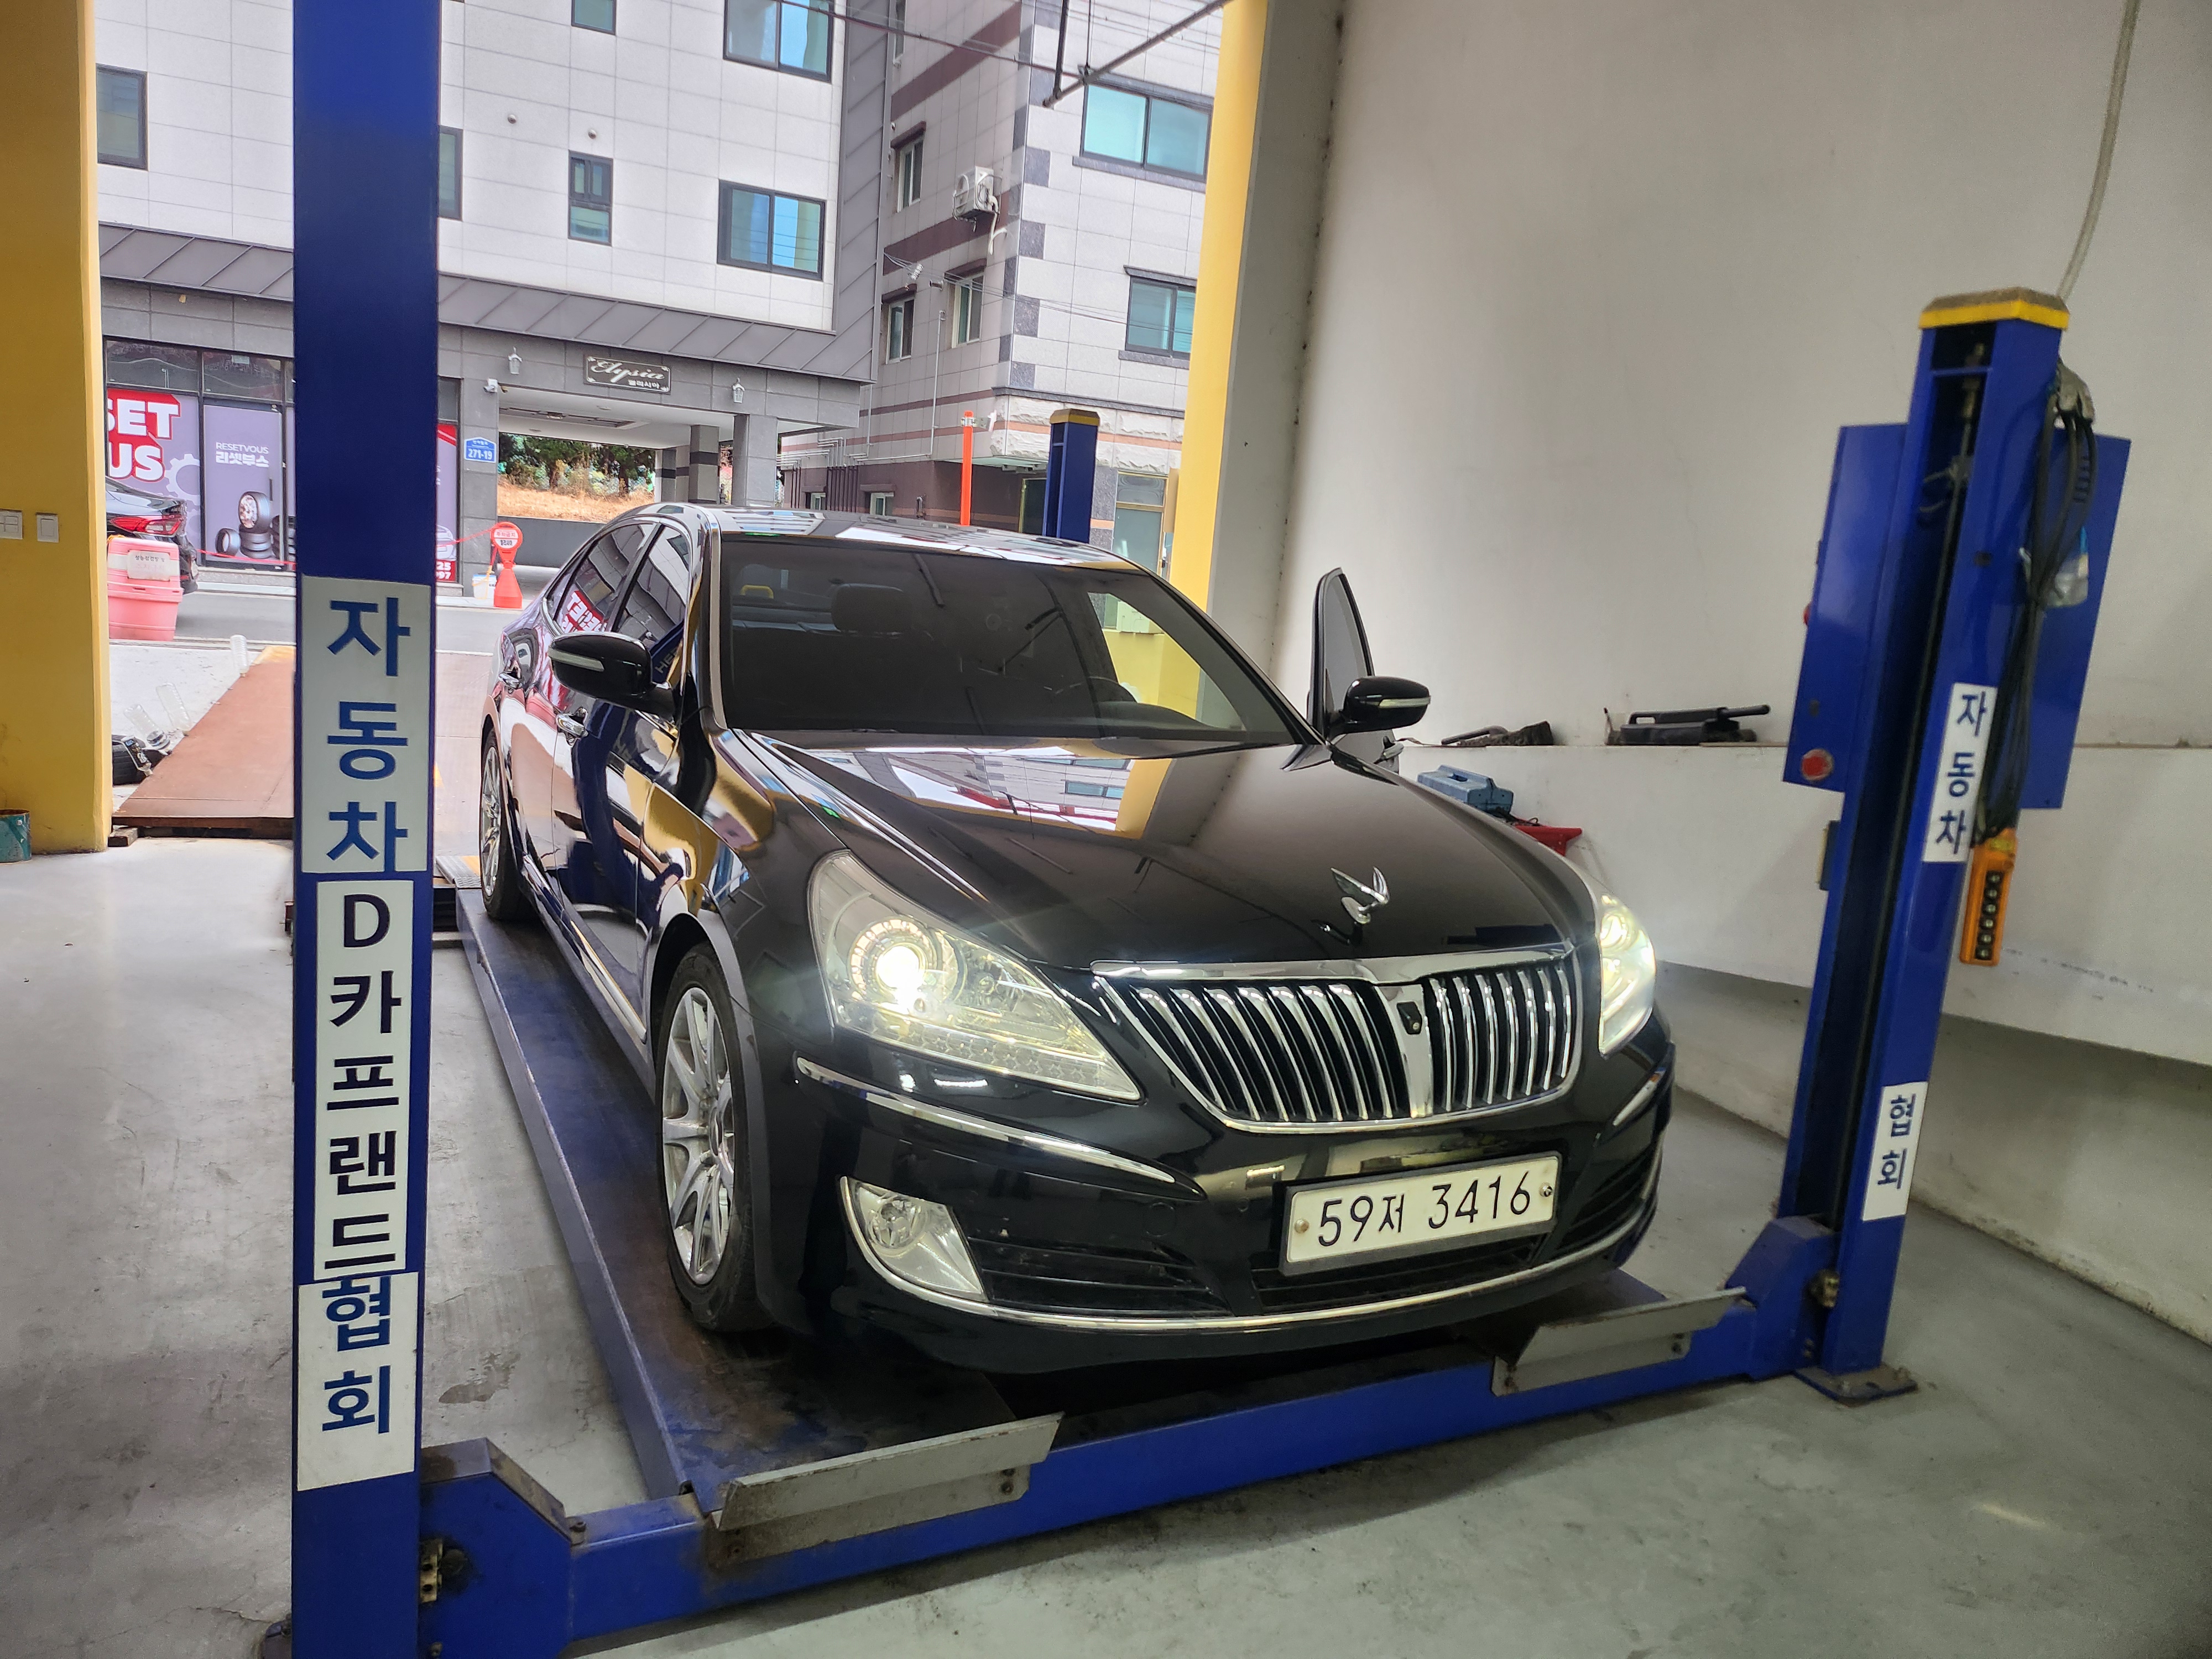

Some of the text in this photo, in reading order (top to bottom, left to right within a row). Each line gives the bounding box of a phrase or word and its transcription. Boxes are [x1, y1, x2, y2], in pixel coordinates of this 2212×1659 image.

[591, 360, 665, 383] Elysia
[216, 442, 269, 455] RESETVOUS
[216, 451, 269, 468] 리셋부스
[468, 448, 493, 460] 271-19
[1877, 691, 1987, 1190] 자동차 협회
[322, 597, 411, 1434] 자동차 D카프랜드 협회
[1317, 1170, 1531, 1248] 59저 3416
